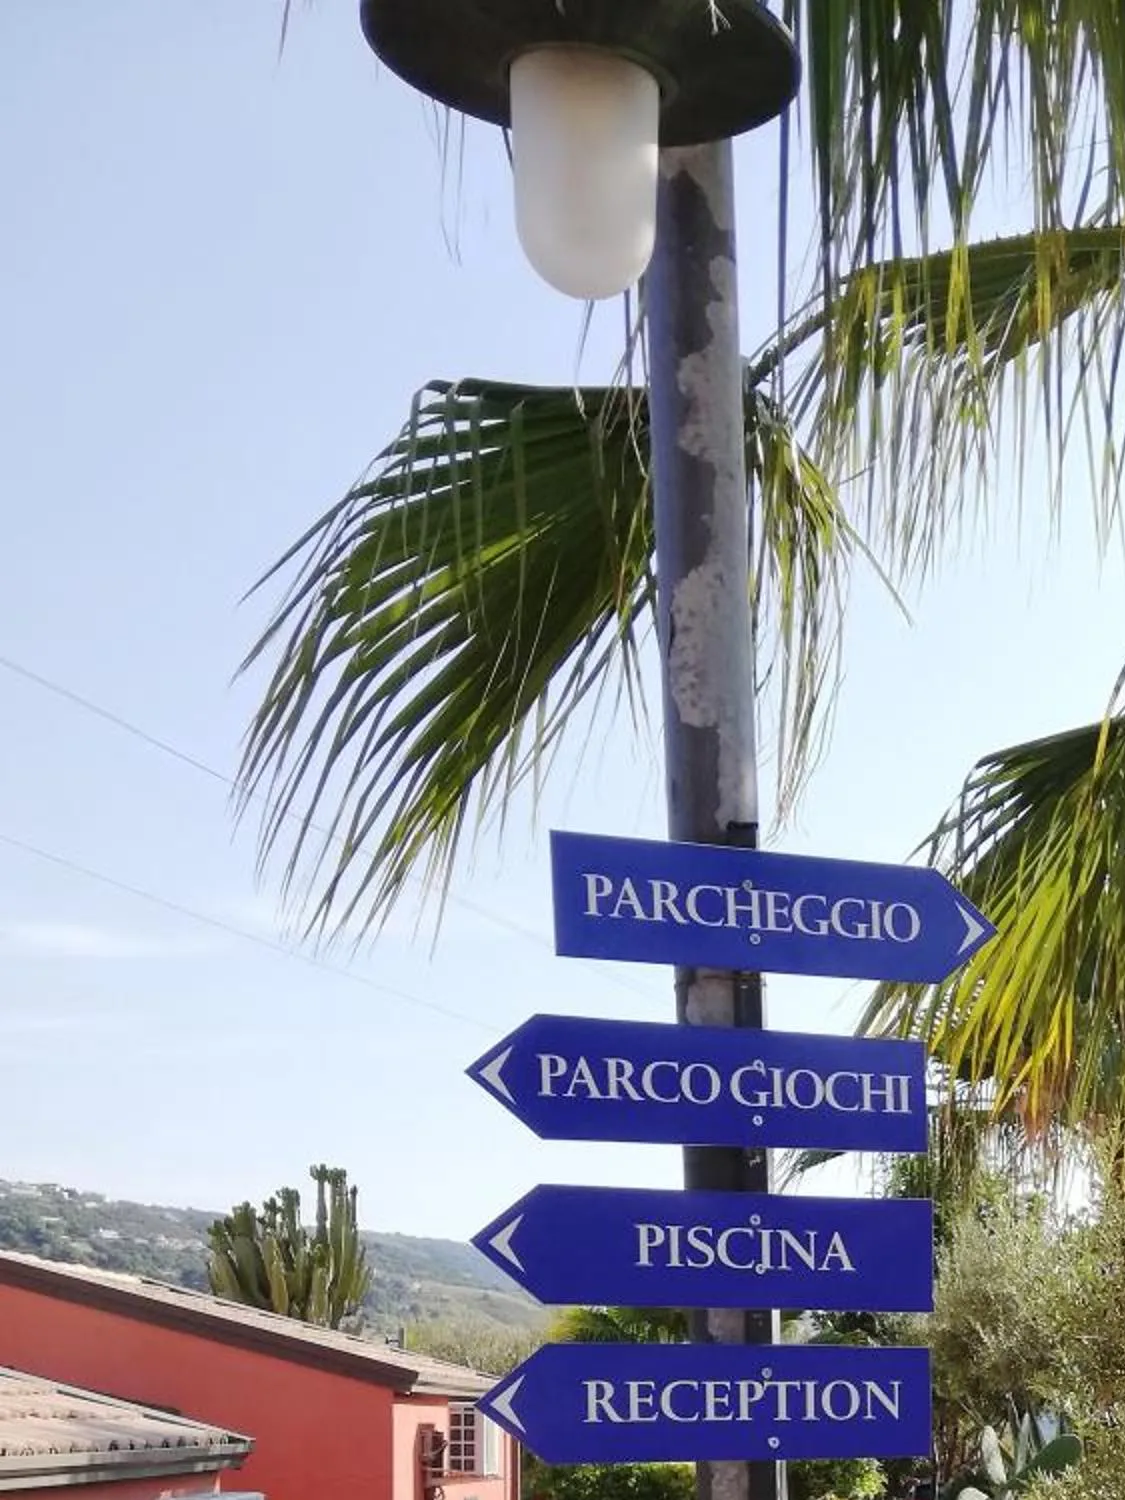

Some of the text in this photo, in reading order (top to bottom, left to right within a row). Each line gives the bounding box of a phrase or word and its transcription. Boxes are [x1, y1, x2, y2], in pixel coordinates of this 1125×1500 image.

[582, 873, 922, 944] PARCHEGGIO
[537, 1053, 912, 1114] PARCO GIOCHI
[634, 1223, 856, 1273] PISCINA
[582, 1379, 900, 1423] RECEPTION
